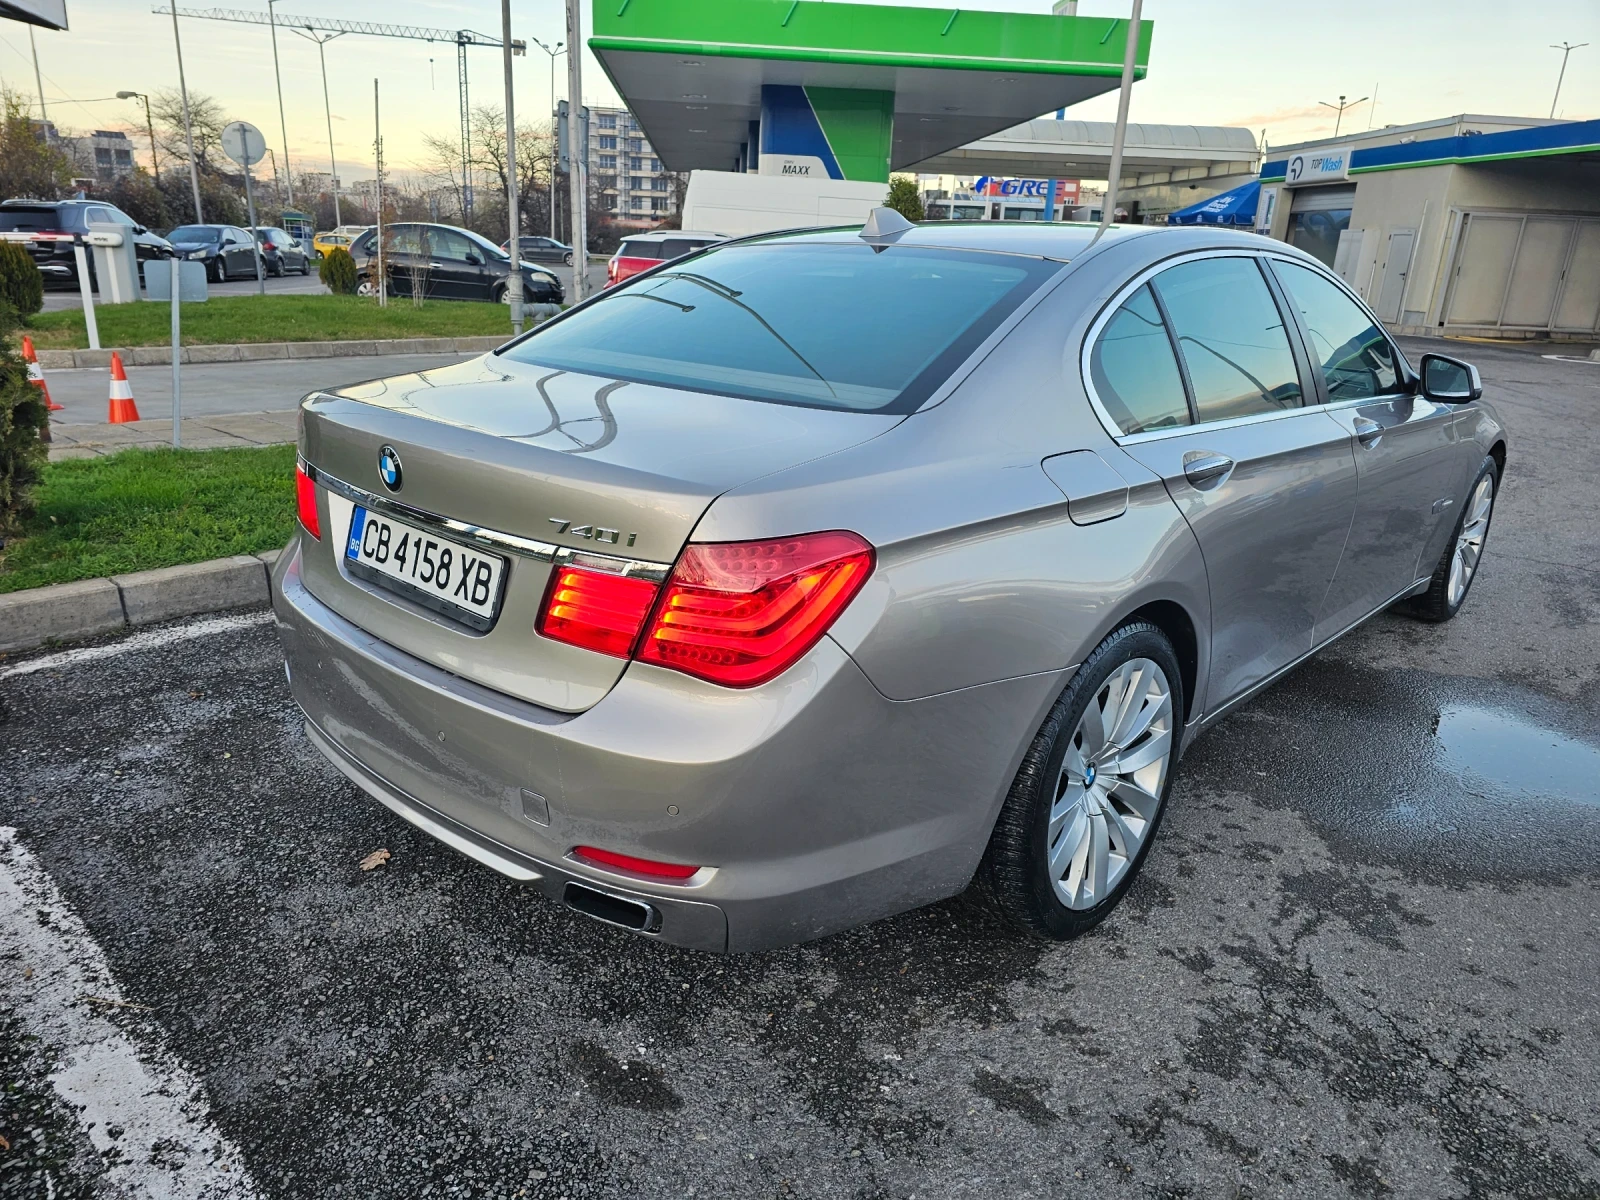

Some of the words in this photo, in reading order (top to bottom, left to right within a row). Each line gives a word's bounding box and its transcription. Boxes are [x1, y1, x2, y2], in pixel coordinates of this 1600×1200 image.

[782, 165, 811, 175] MAXX
[350, 538, 360, 551] BG
[363, 519, 392, 564] CB
[394, 532, 453, 590] 4158
[453, 553, 492, 606] XB
